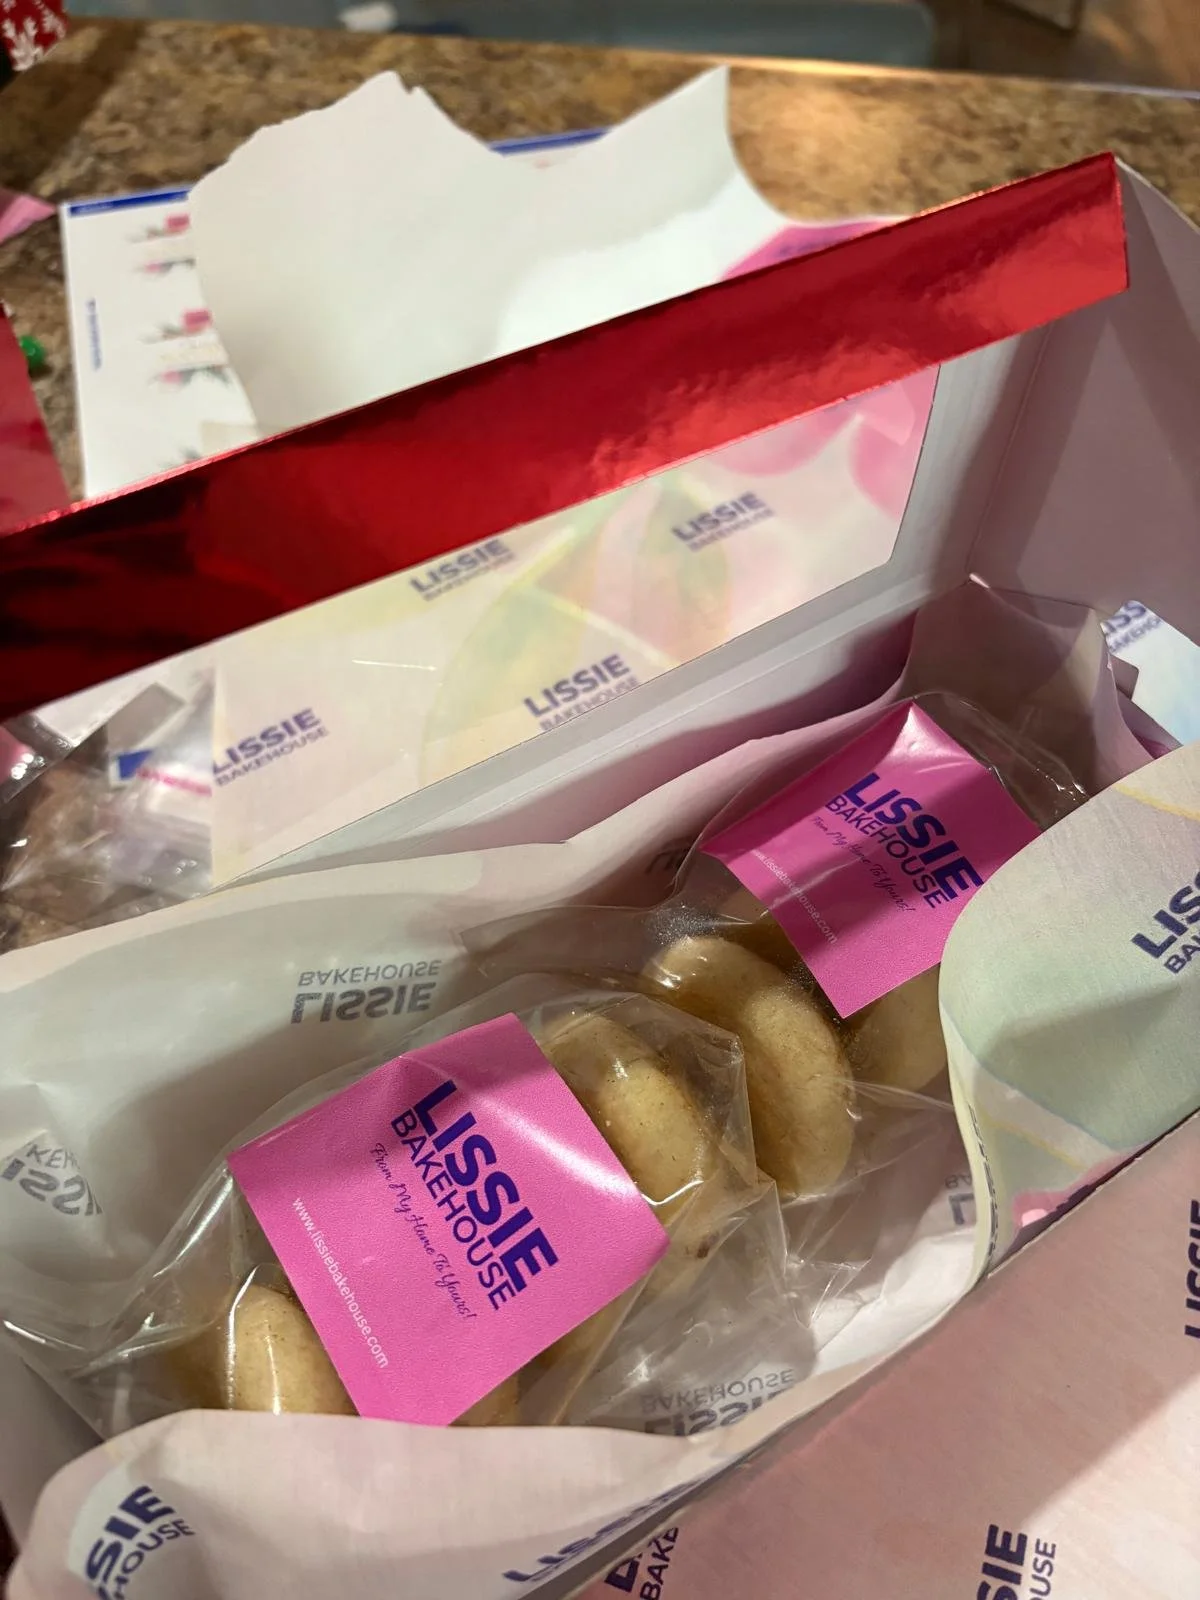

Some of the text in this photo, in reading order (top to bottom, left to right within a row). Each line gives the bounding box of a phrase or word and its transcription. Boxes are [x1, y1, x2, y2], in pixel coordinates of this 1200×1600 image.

[410, 539, 511, 593] LISSIE
[671, 491, 766, 542] LISSIE
[212, 708, 322, 775] LISSIE
[523, 653, 631, 718] LISSIE
[216, 725, 331, 787] BAKEHOUSE
[825, 795, 950, 908] BAKEHOUSE
[842, 772, 984, 900] LISSIE
[370, 1142, 478, 1319] From My Home To Yours!
[391, 1109, 517, 1311] BAKEHOUSE
[412, 1079, 559, 1293] LISSIE
[292, 1197, 389, 1369] www.lissiebakehouse.com
